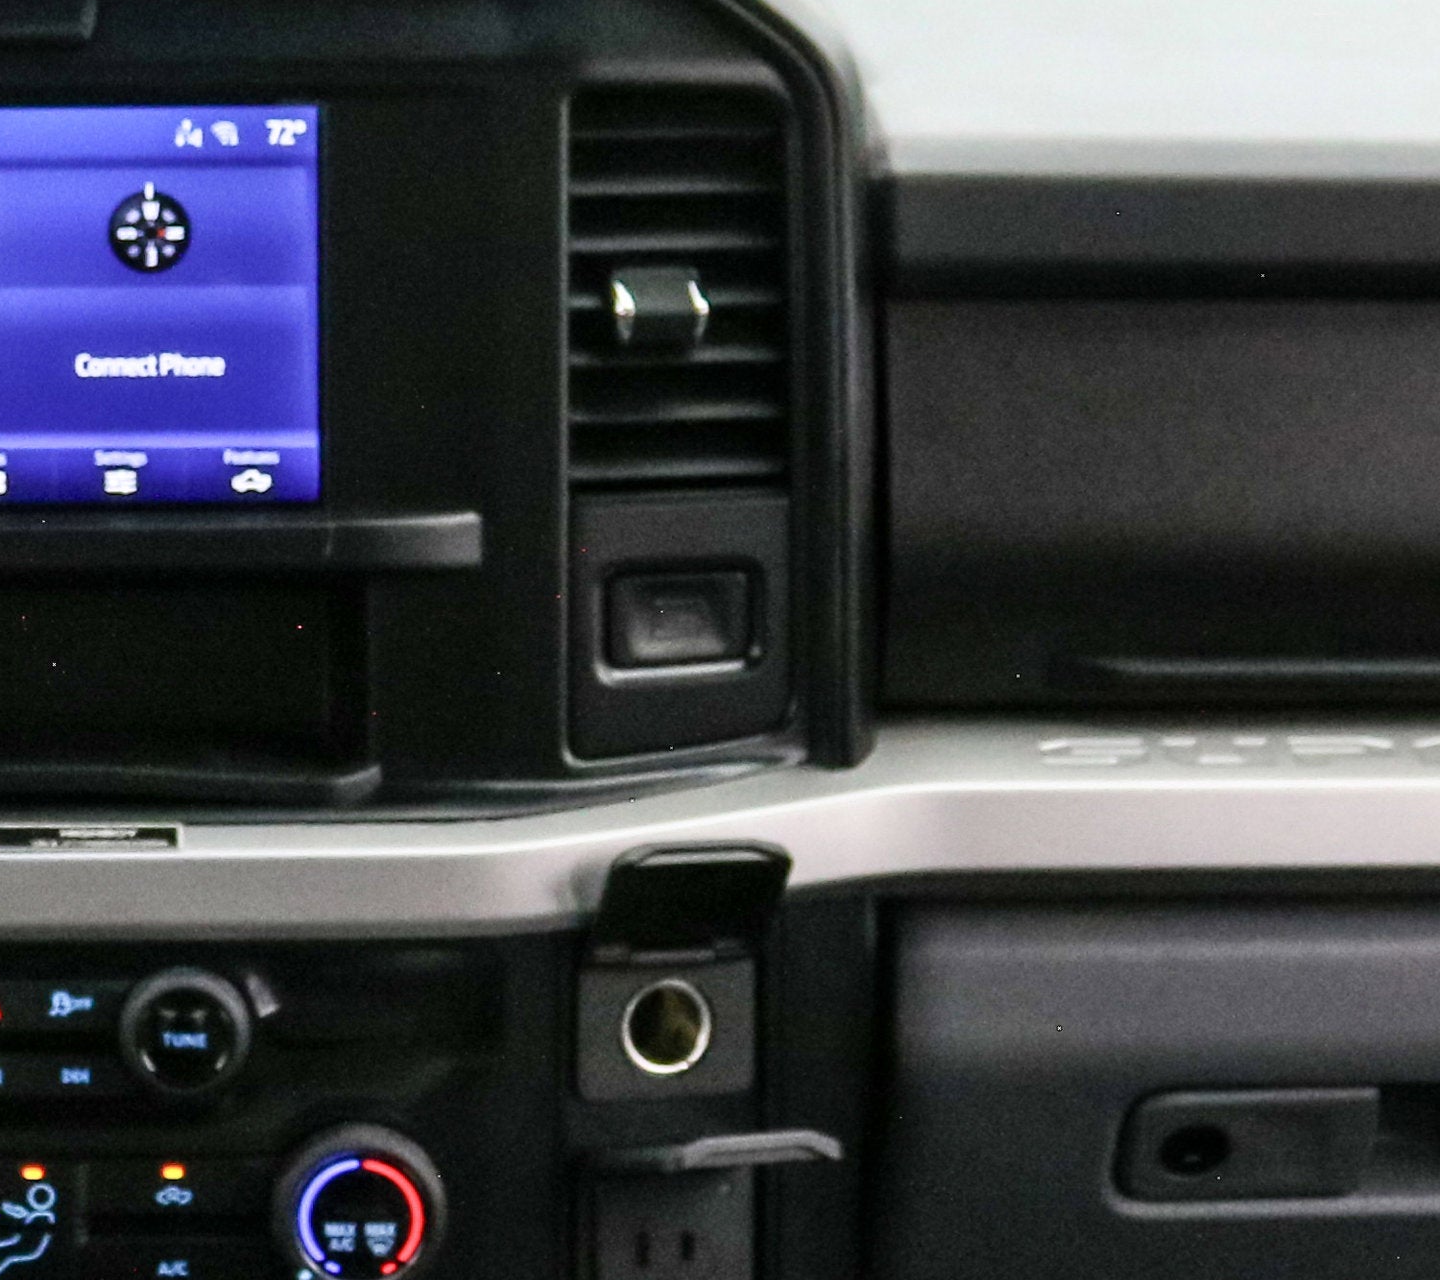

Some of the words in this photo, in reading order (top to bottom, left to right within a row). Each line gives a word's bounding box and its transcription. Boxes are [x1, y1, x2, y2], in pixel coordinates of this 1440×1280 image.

[265, 118, 307, 147] 72°
[74, 352, 157, 379] Connect
[159, 352, 225, 379] Phone
[162, 1032, 208, 1049] TUNE
[157, 1260, 189, 1278] A/C
